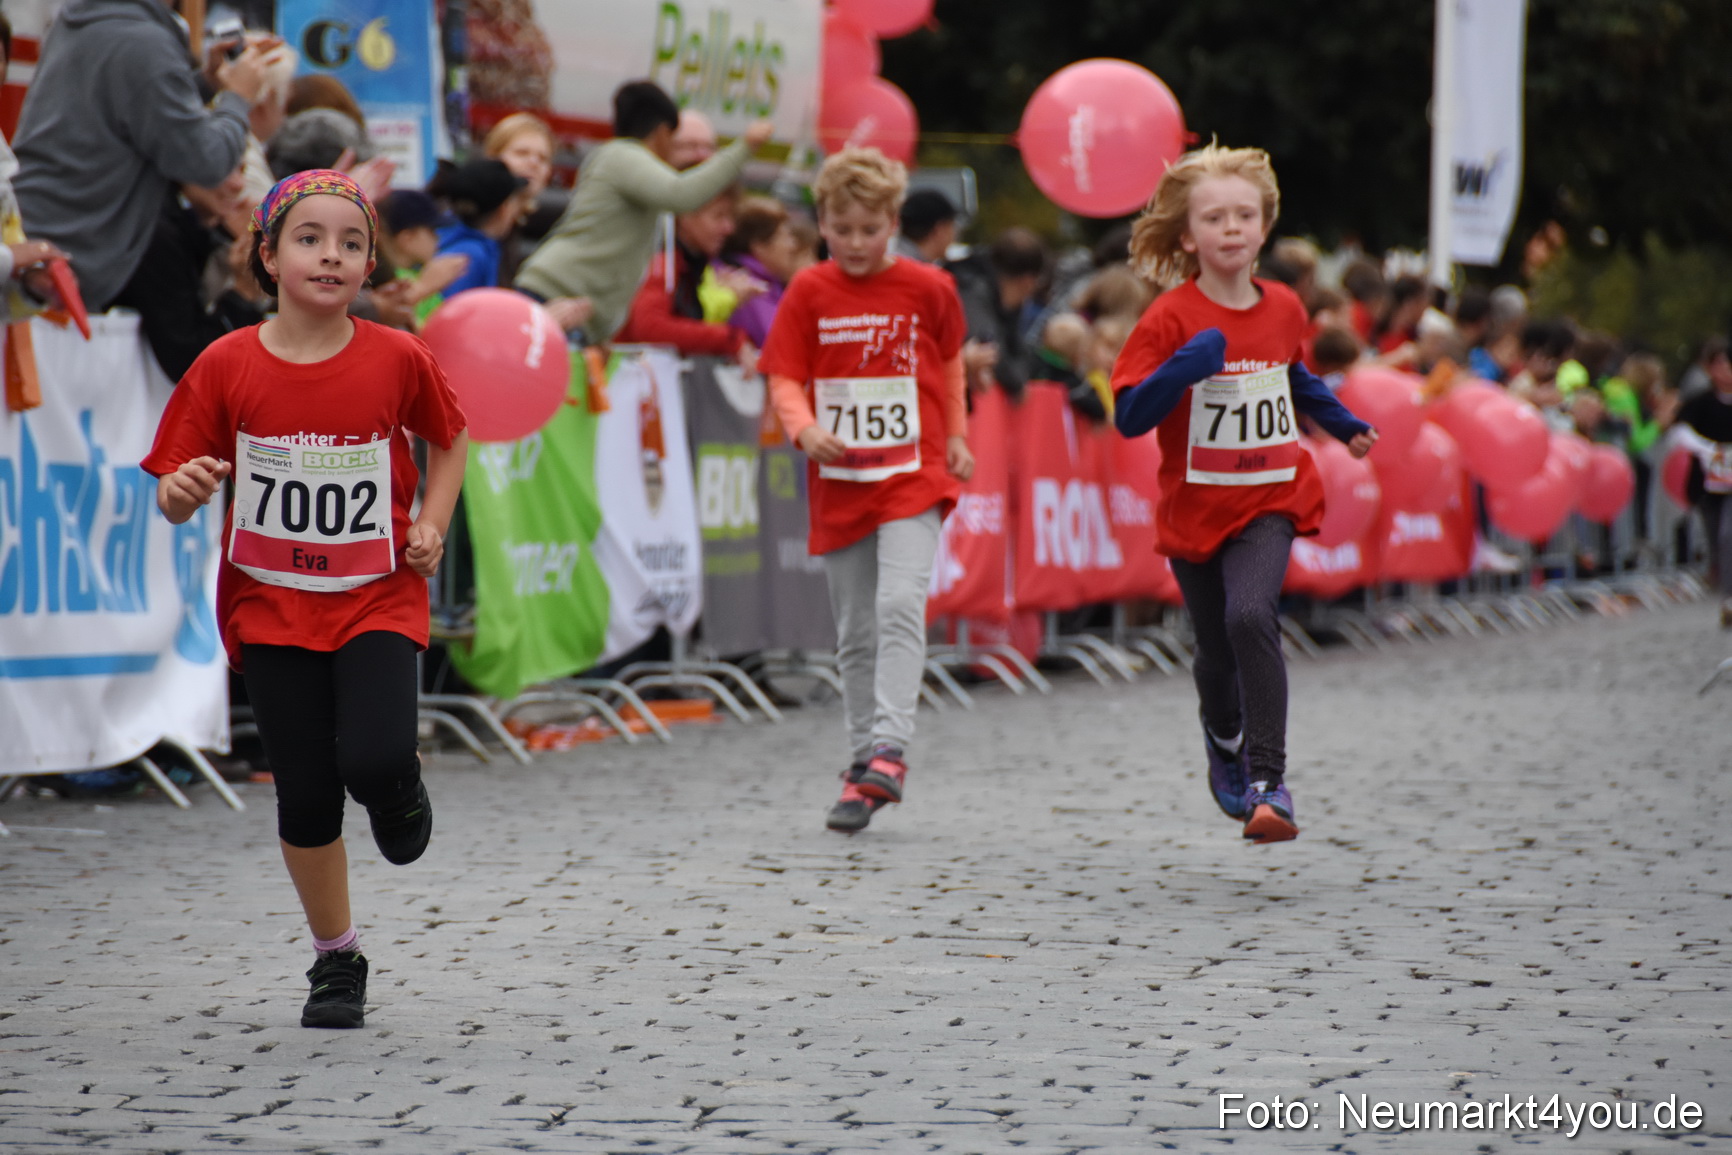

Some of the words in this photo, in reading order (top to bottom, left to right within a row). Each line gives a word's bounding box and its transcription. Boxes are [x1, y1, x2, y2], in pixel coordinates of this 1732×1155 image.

[649, 1, 785, 118] Pellets
[826, 403, 908, 441] 7153
[1204, 395, 1290, 442] 7108
[246, 452, 293, 469] NeuerMarkt
[302, 448, 378, 469] BOCK
[251, 472, 378, 537] 7002
[292, 548, 328, 571] Eva
